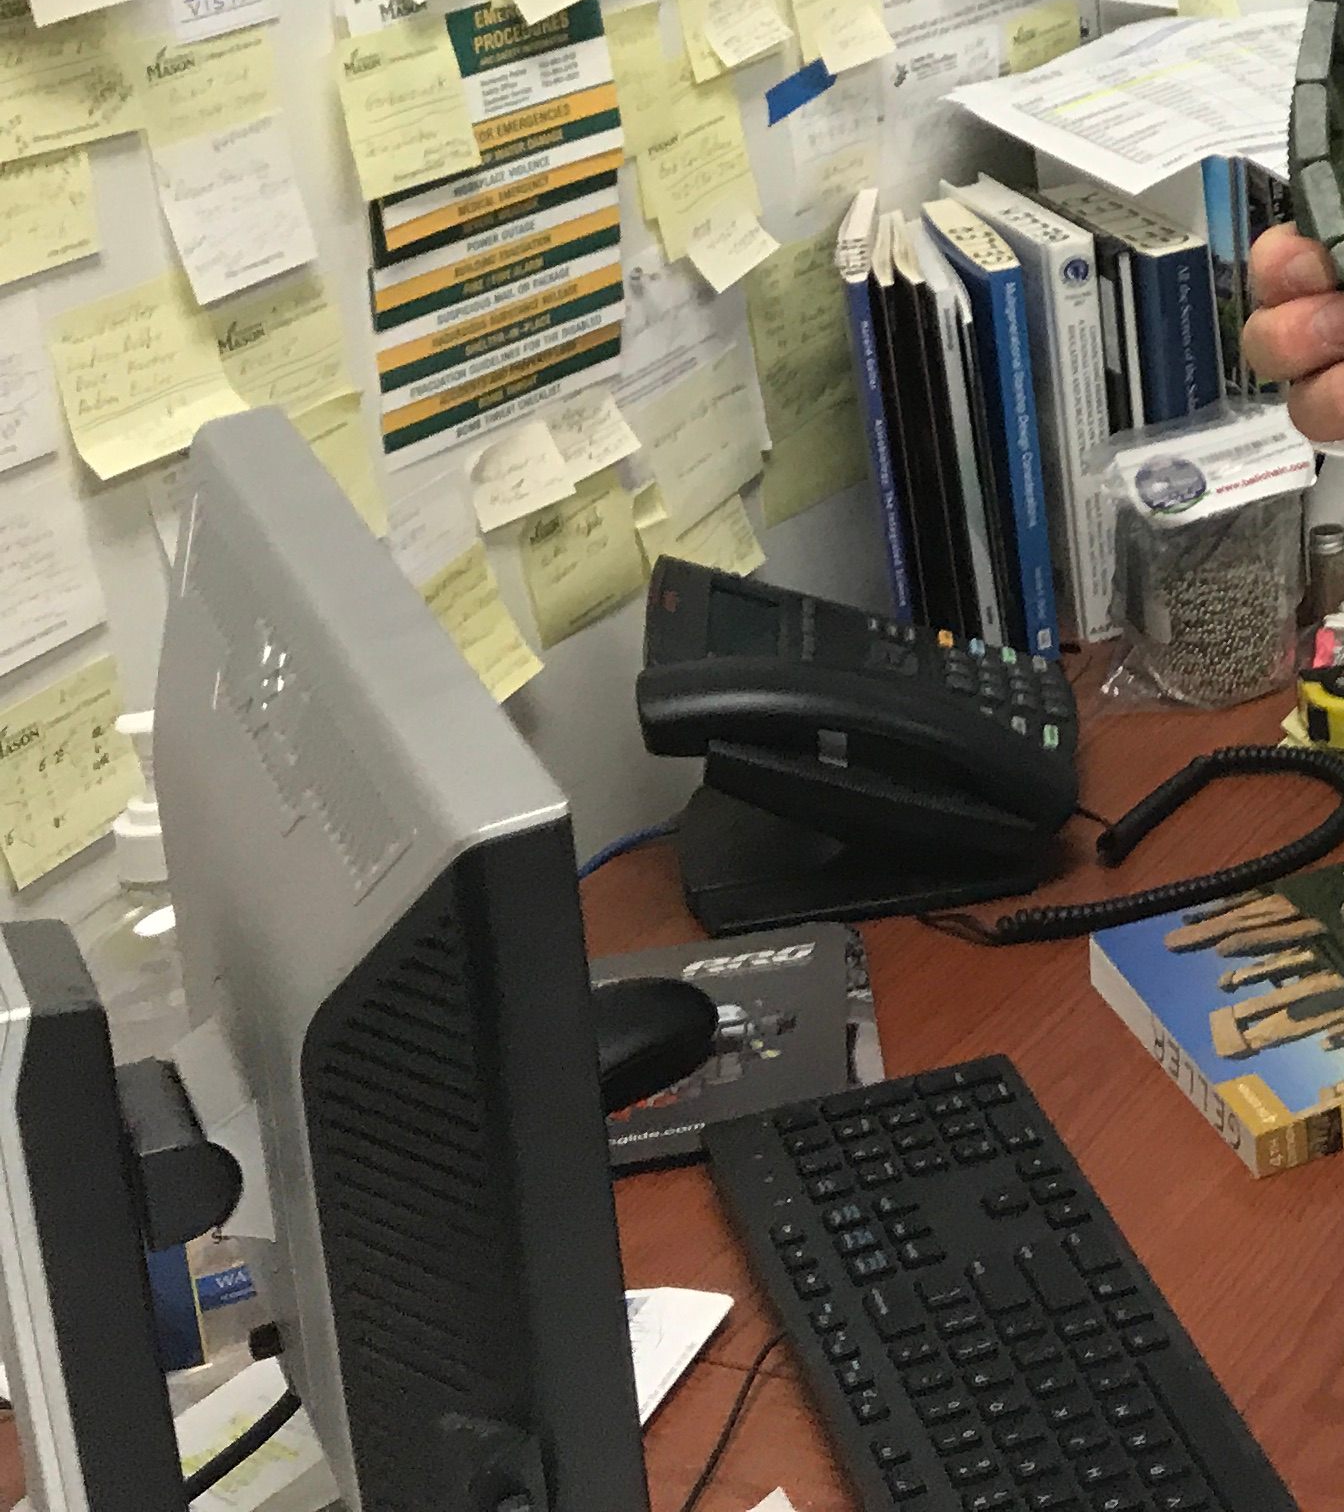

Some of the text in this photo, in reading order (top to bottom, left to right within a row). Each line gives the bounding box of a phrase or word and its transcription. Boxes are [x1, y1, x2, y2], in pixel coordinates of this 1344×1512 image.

[508, 155, 550, 179] VIOLENCE
[466, 220, 536, 253] POWER OUTAGE
[532, 266, 571, 292] PACKAGE
[1151, 1019, 1242, 1150] GELLER
